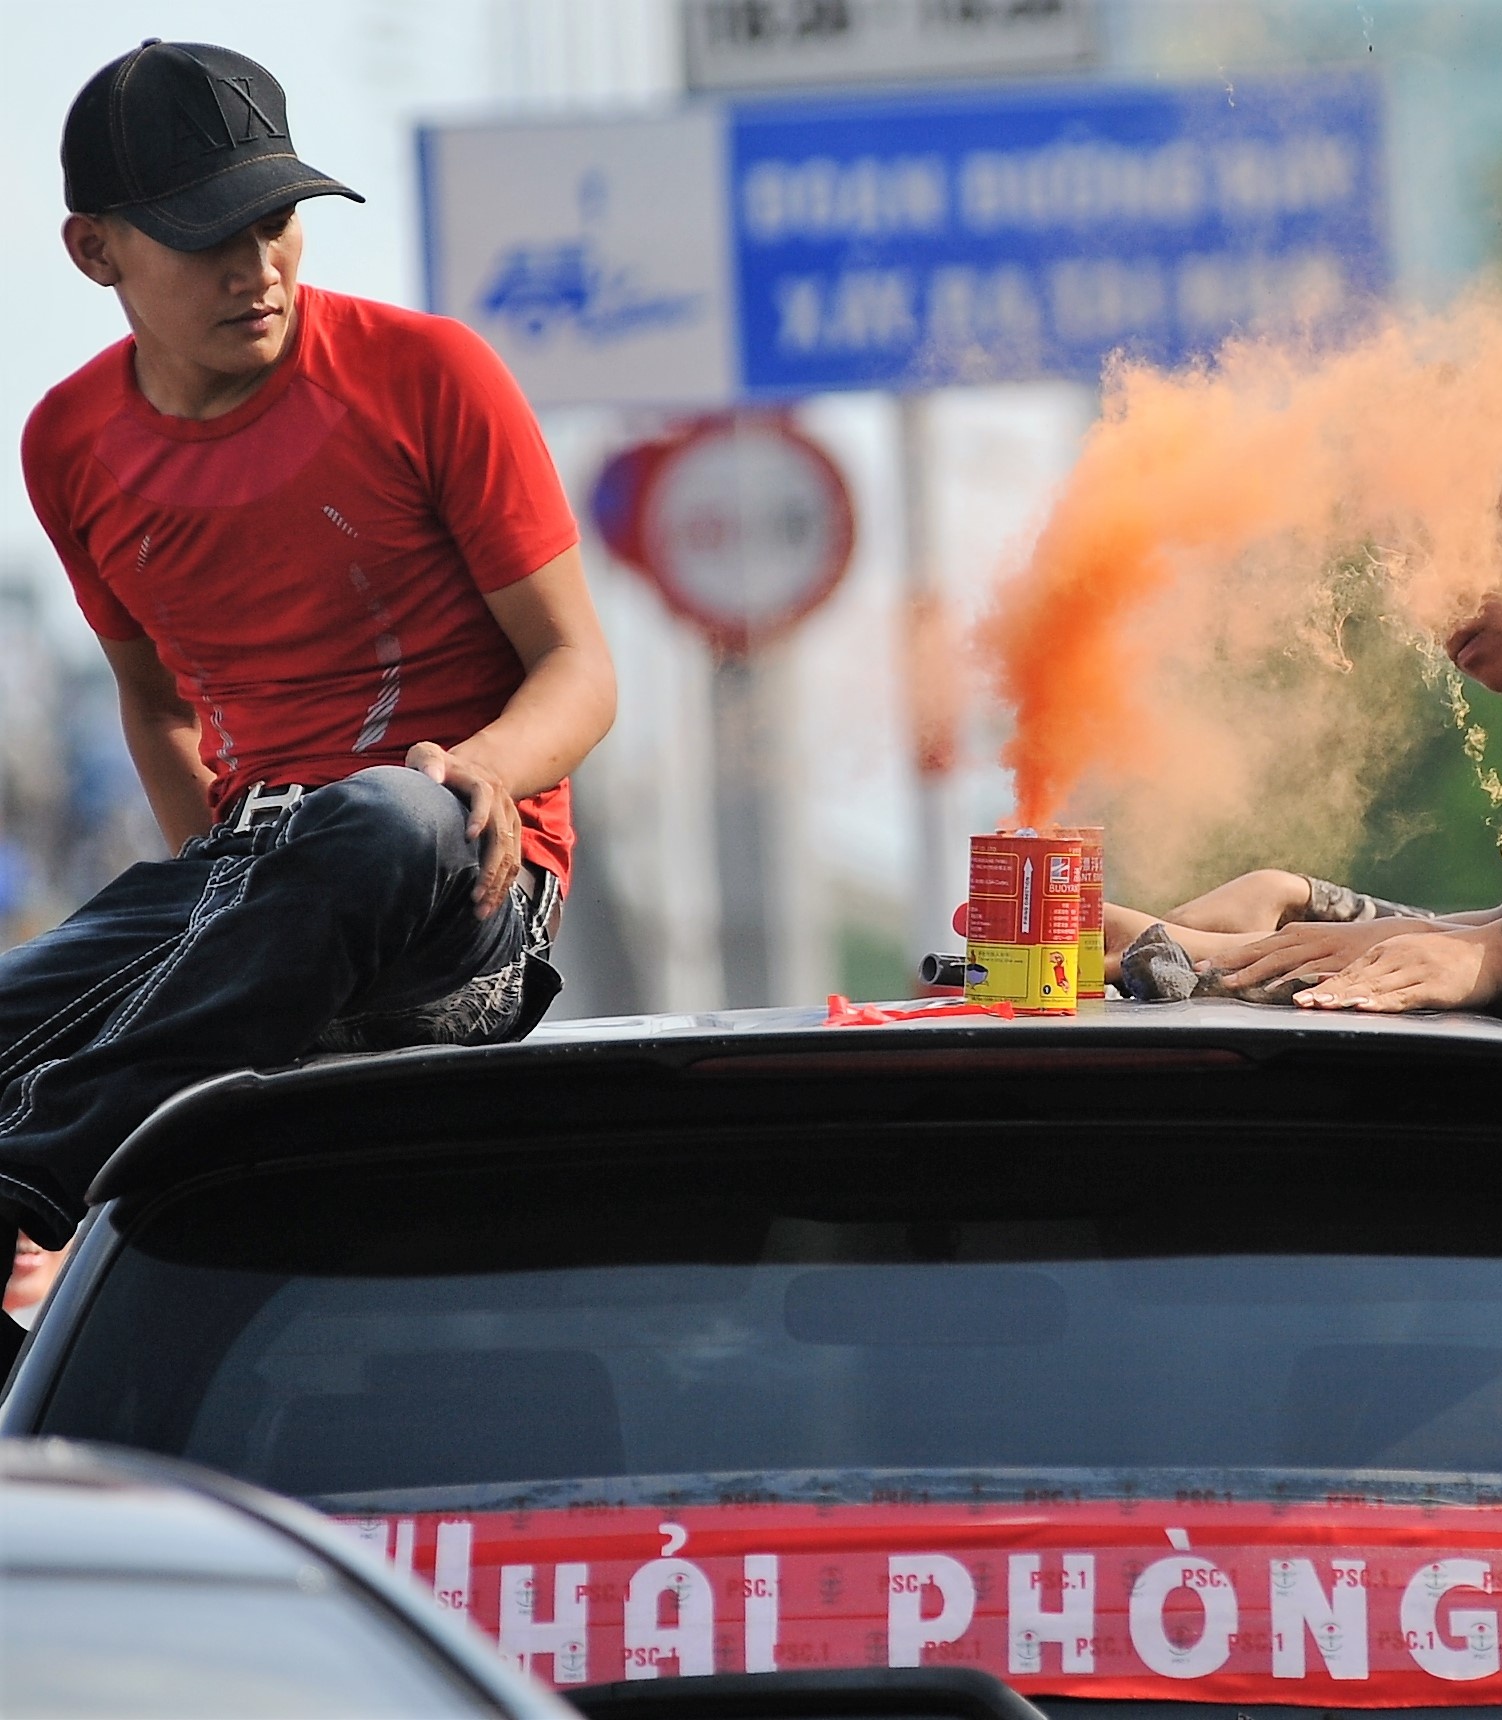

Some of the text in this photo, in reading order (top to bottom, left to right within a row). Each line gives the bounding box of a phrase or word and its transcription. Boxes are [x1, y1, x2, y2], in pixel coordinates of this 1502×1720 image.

[437, 1589, 479, 1610] SC.1
[575, 1584, 631, 1604] PSC.1
[726, 1578, 782, 1598] PSC.1
[879, 1574, 934, 1594] PSC.1
[1029, 1570, 1087, 1591] PSC.1
[1181, 1568, 1238, 1588] PSC.1
[1333, 1568, 1389, 1588] PSC.1
[499, 1524, 1501, 1684] HẢI PHÒNG
[624, 1646, 679, 1667] PSC.1
[773, 1642, 829, 1662] PSC.1
[923, 1639, 980, 1660] PSC.1
[1076, 1637, 1132, 1657] PSC.1
[1227, 1632, 1284, 1652] PSC.1
[1378, 1630, 1435, 1650] PSC.1
